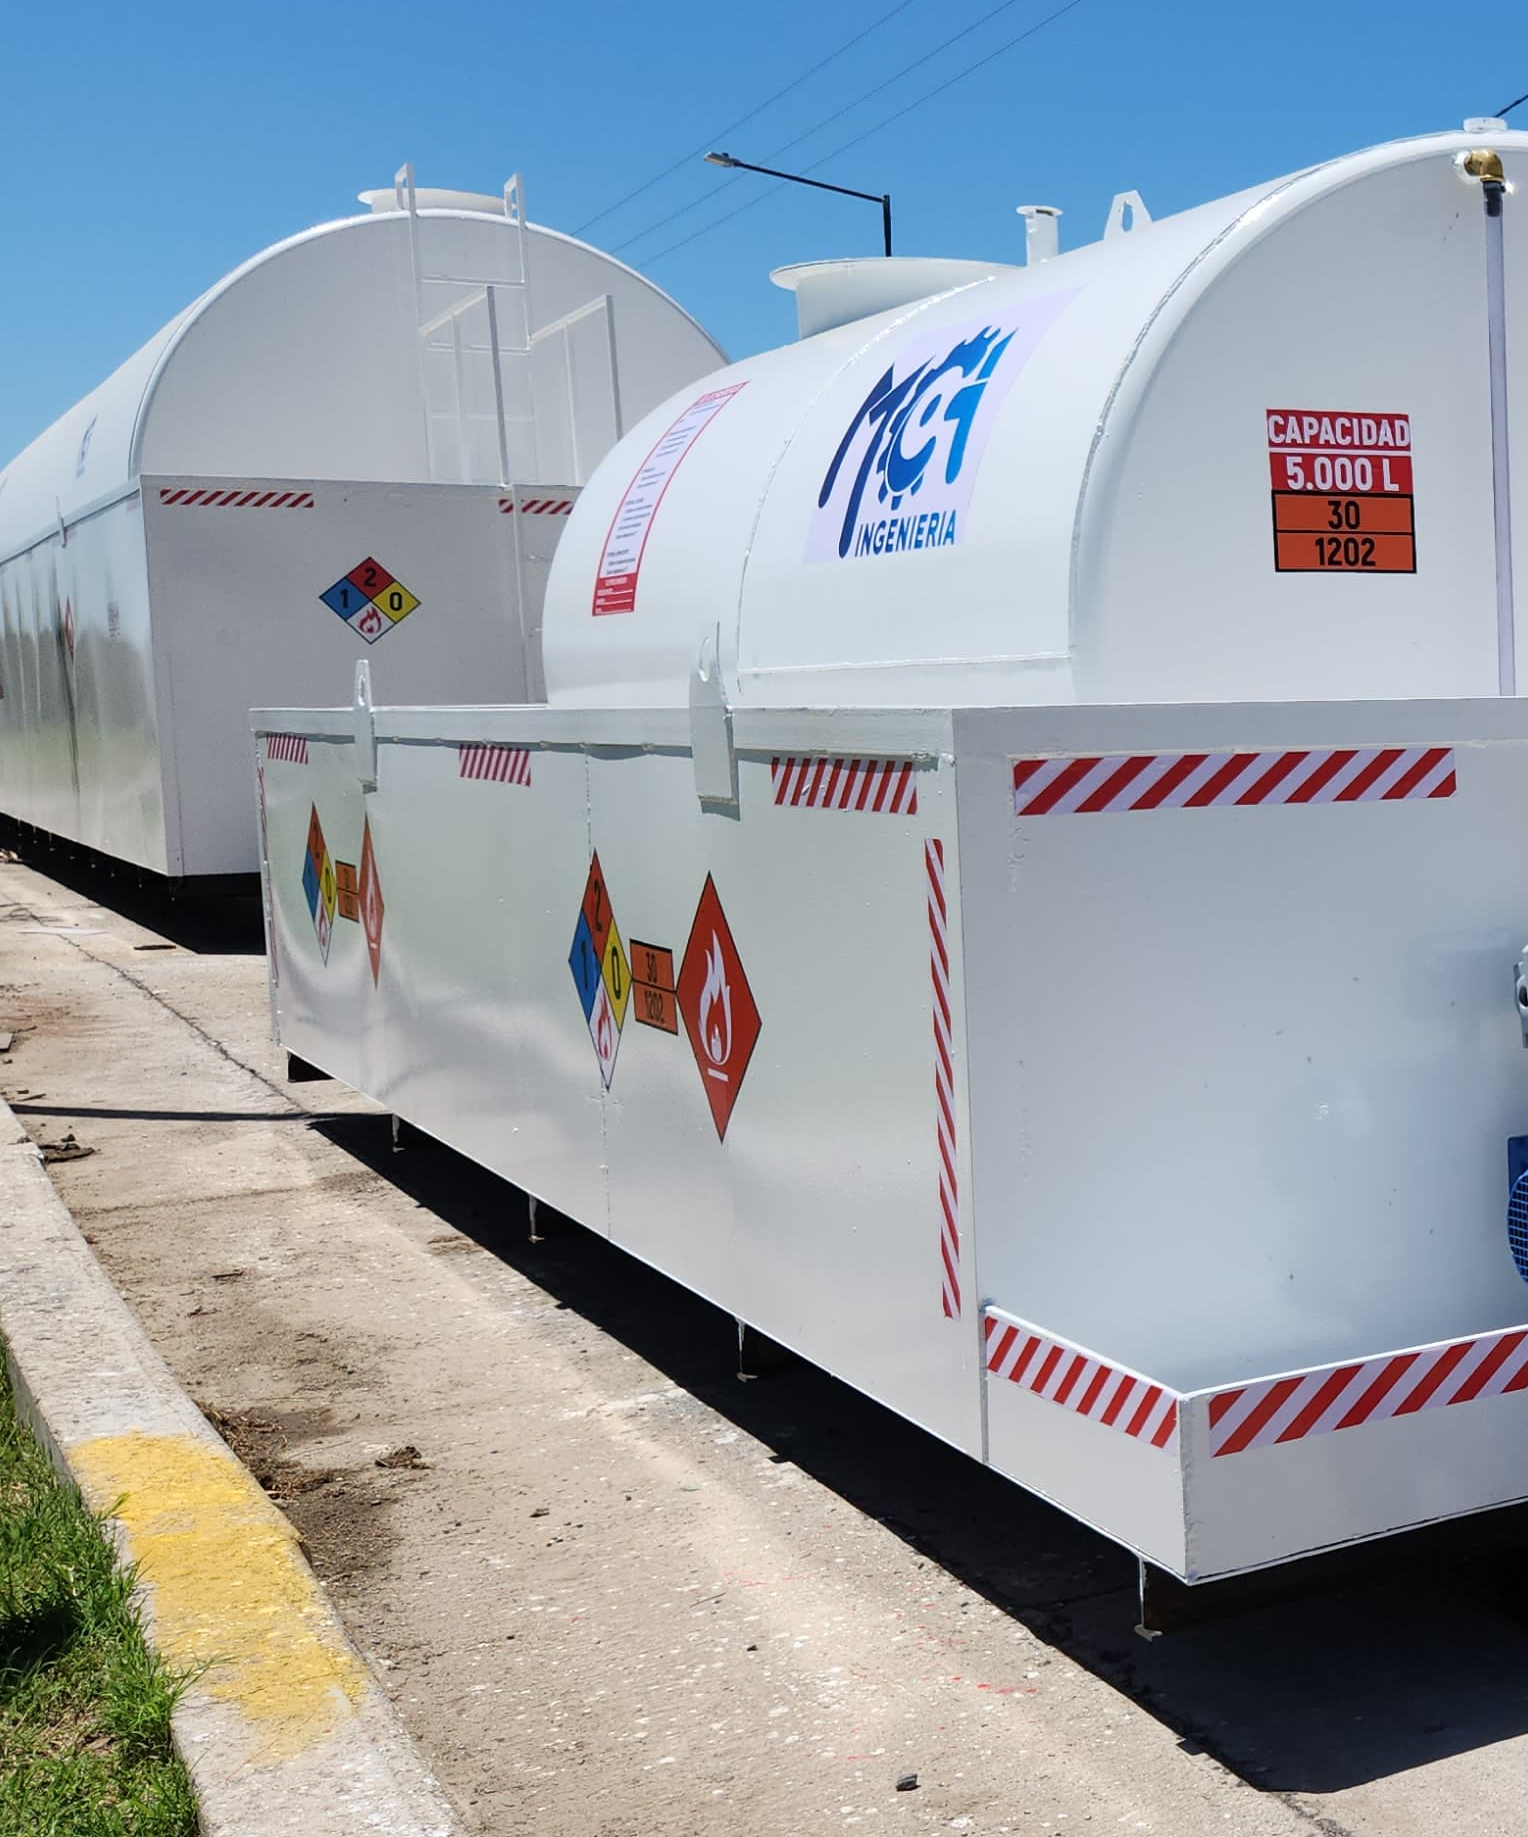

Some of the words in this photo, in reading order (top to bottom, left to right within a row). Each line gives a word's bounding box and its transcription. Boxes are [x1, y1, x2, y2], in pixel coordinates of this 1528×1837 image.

[1268, 414, 1411, 447] CAPACIDAD
[1286, 455, 1373, 491] 5.000
[1382, 458, 1400, 492] L
[1328, 501, 1361, 530] 30
[854, 509, 956, 557] INGENIERIA
[1315, 537, 1376, 567] 1202
[364, 567, 377, 587] 2
[340, 588, 349, 609] 1
[389, 592, 403, 611] 0
[594, 879, 602, 932] 2
[581, 940, 589, 990] 1
[611, 946, 621, 1000] 0
[645, 952, 658, 983] 30
[644, 990, 666, 1024] 1202
